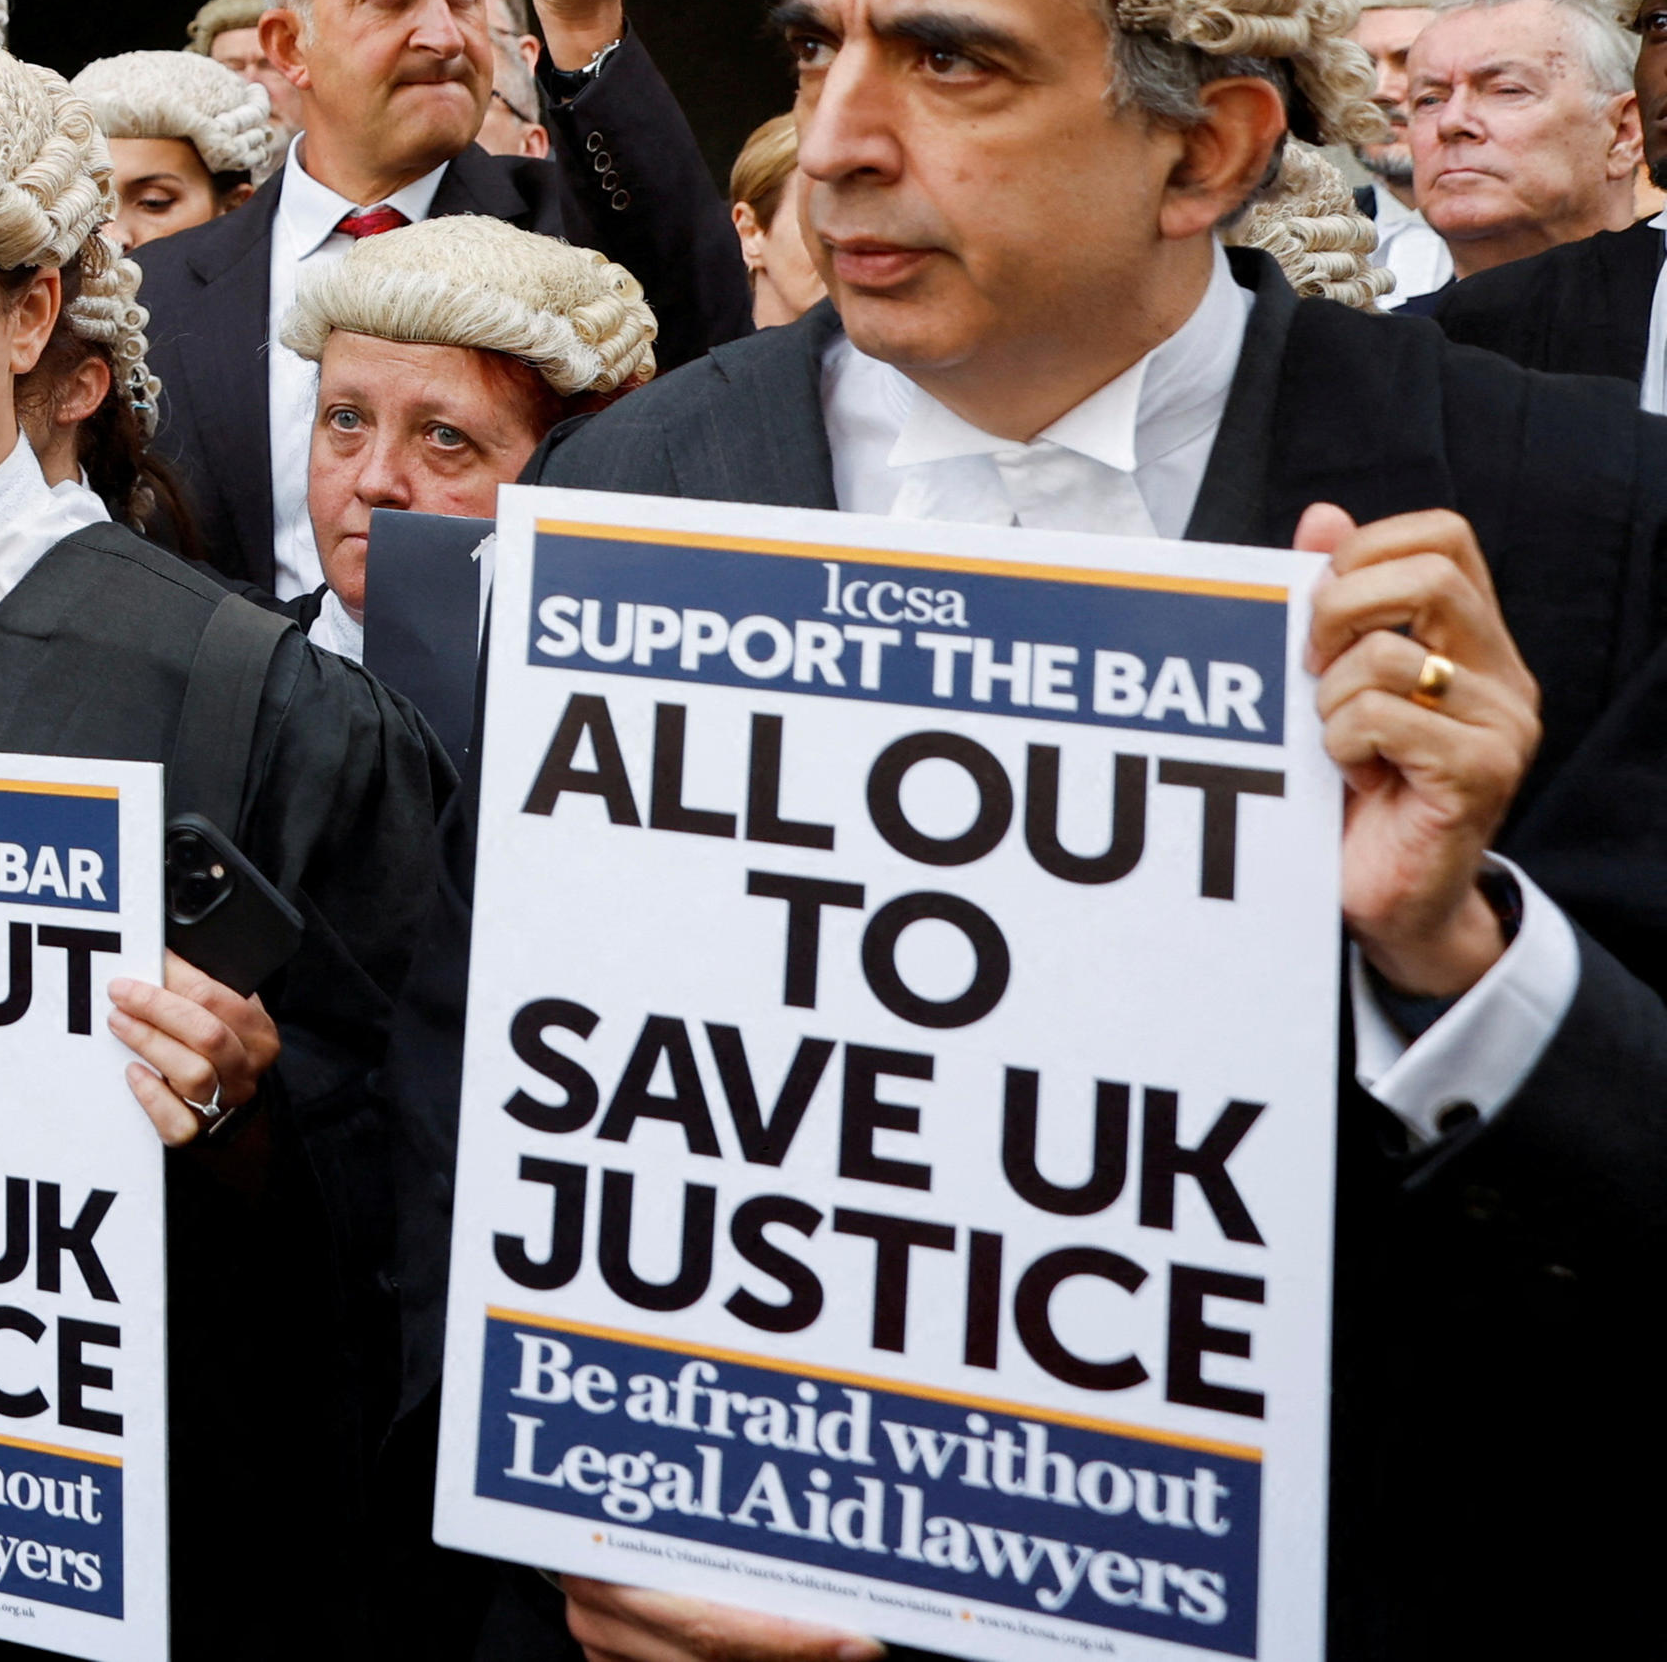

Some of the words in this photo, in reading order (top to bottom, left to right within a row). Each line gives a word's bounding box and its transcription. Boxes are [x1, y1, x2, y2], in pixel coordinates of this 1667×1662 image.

[535, 594, 900, 690] SUPPORT
[918, 632, 1078, 712] THE
[1093, 649, 1265, 733] BAR
[823, 563, 969, 629] lccsa
[521, 691, 836, 851] ALL
[866, 731, 1286, 902] OUT
[746, 868, 1011, 1029] TO
[501, 997, 936, 1194] SAVE
[1001, 1065, 1269, 1247] UK
[492, 1152, 1268, 1421] JUSTICE
[503, 1414, 723, 1521] Legal
[736, 1457, 892, 1555] Aid
[894, 1483, 1228, 1625] lawyers
[509, 1331, 620, 1410] Be
[625, 1356, 874, 1466] afraid
[881, 1416, 1232, 1538] without
